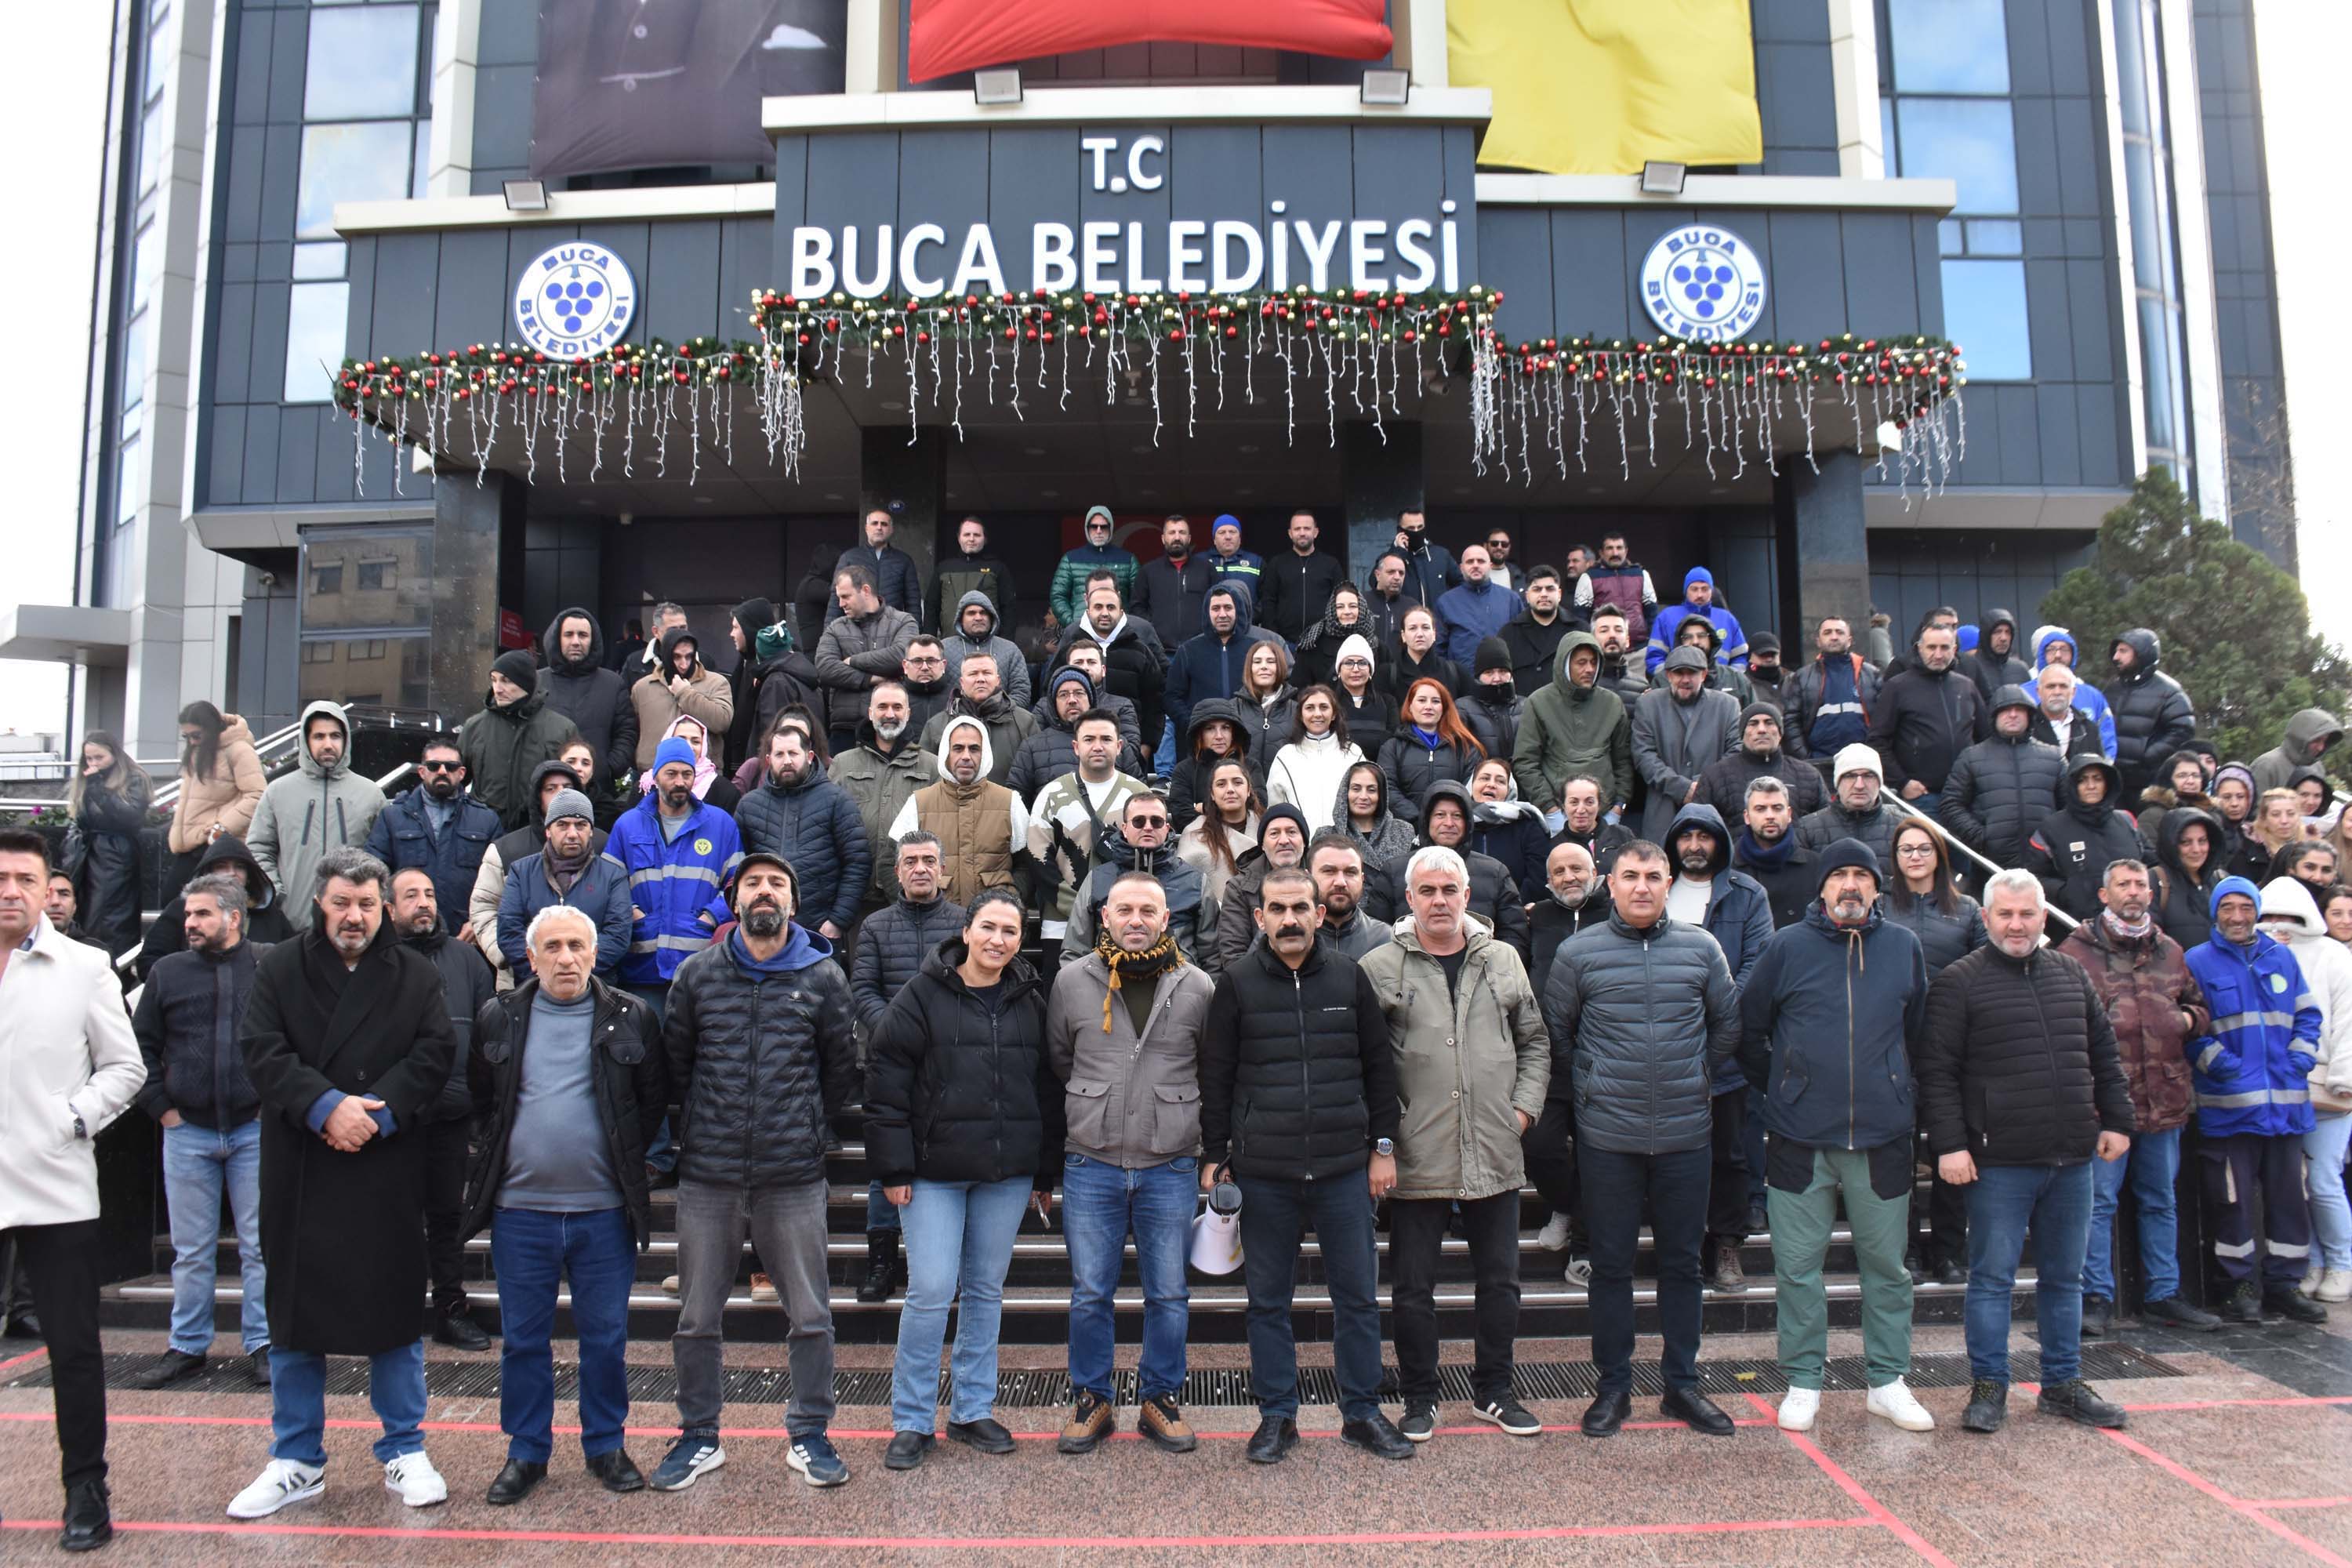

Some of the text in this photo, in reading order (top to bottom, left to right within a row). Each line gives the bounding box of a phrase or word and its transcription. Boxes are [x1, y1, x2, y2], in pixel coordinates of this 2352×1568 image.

[1082, 136, 1163, 192] T.C
[542, 249, 609, 271] BUCA
[791, 200, 1458, 299] BUCA BELEDİYESİ
[1667, 231, 1736, 255] BUCA
